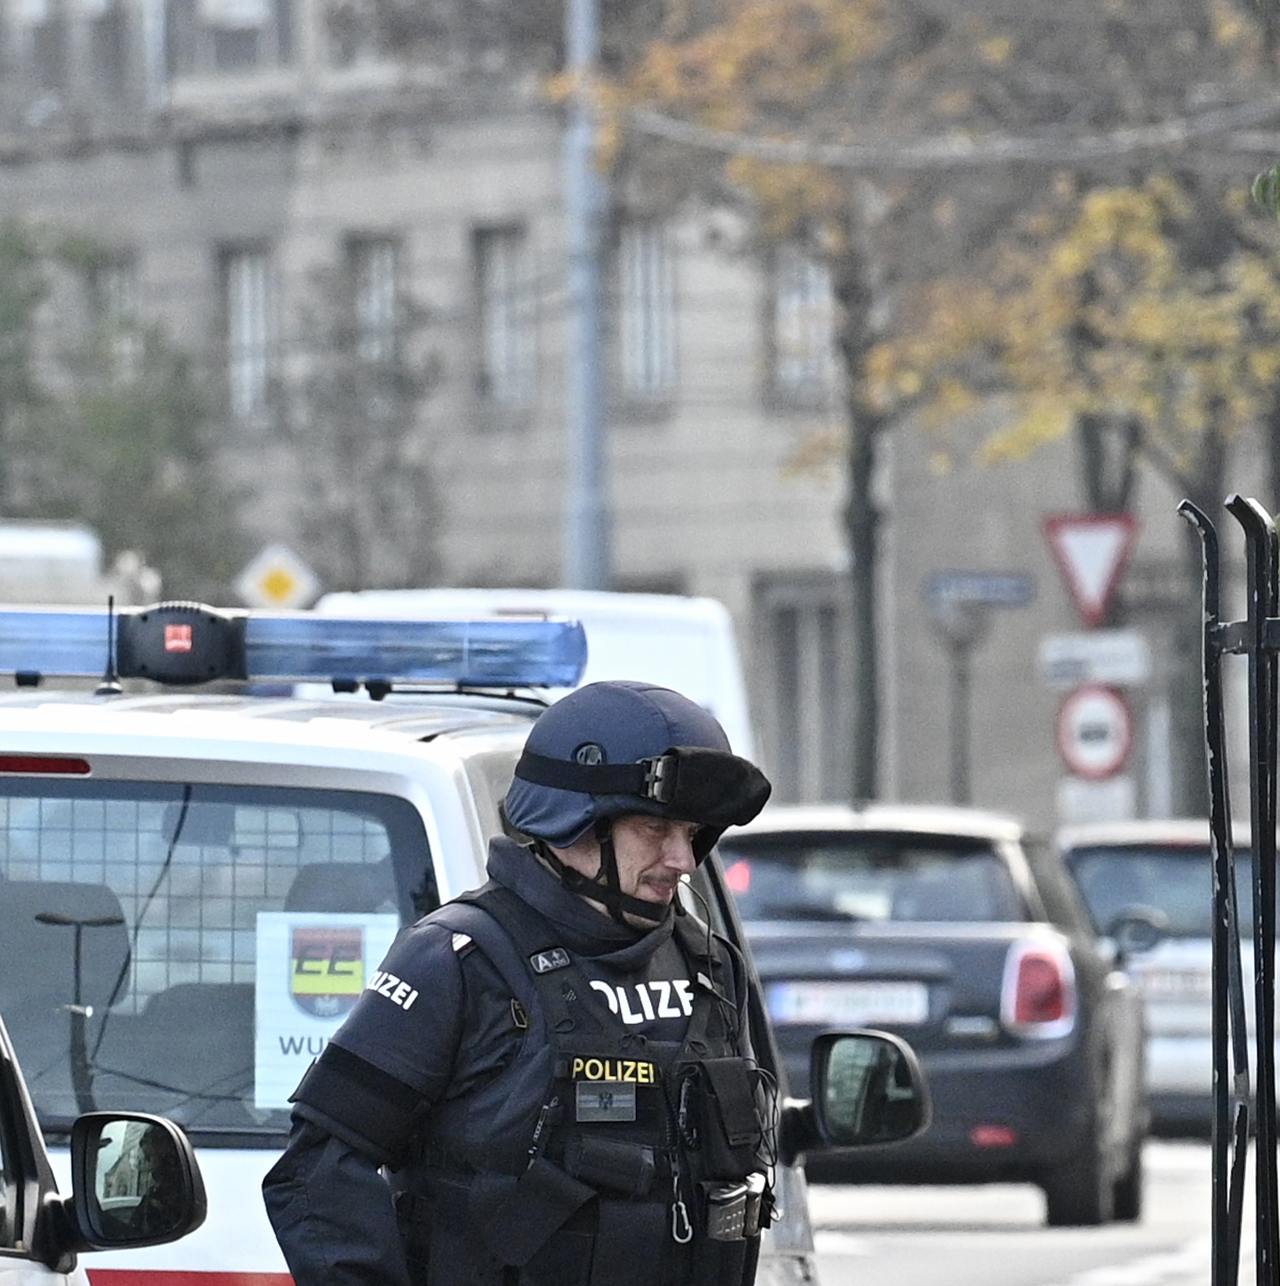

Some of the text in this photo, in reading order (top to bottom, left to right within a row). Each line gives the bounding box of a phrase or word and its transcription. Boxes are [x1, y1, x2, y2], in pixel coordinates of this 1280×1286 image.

[367, 971, 419, 1010] LIZEI
[590, 980, 694, 1024] OLIZE
[279, 1036, 331, 1055] WU
[572, 1058, 655, 1083] POLIZEI
